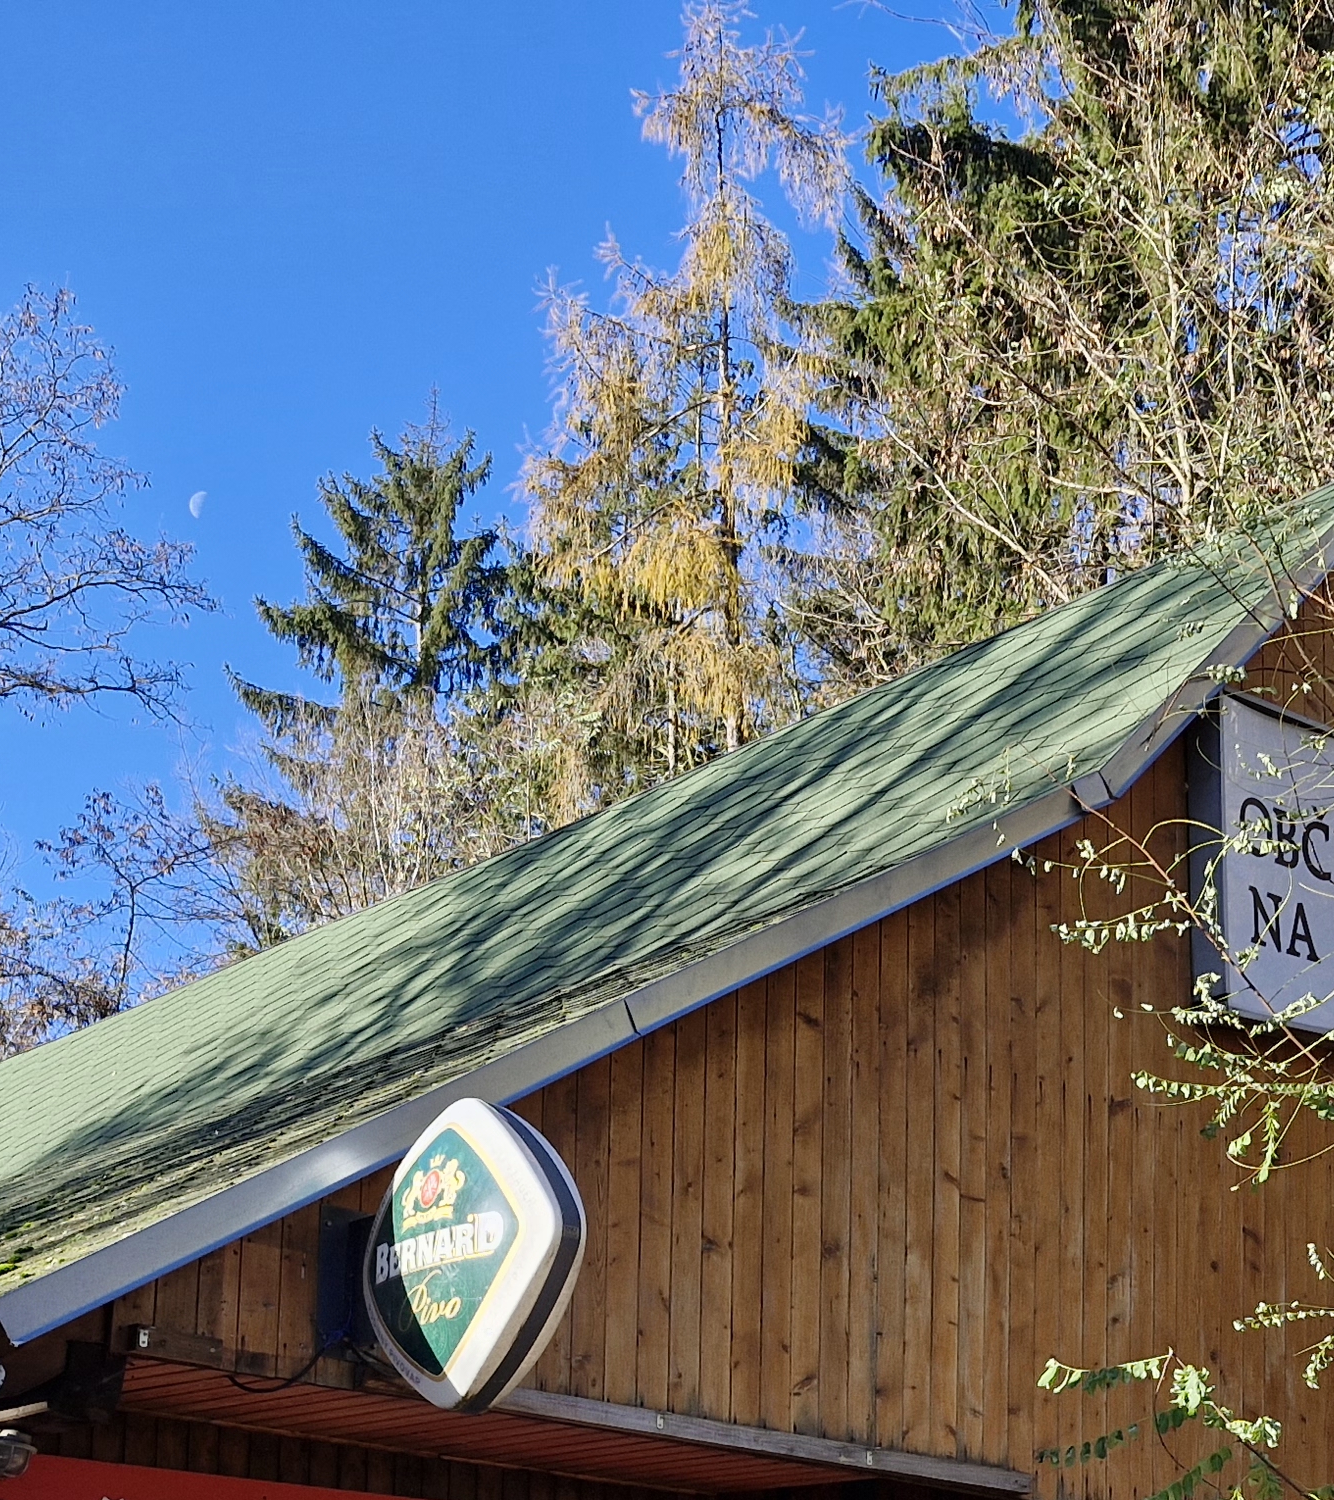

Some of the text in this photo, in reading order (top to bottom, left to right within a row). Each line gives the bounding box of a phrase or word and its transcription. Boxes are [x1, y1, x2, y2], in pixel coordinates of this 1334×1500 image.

[1248, 884, 1321, 963] NA
[375, 1211, 505, 1285] BERNARD
[399, 1270, 461, 1332] Pivo
